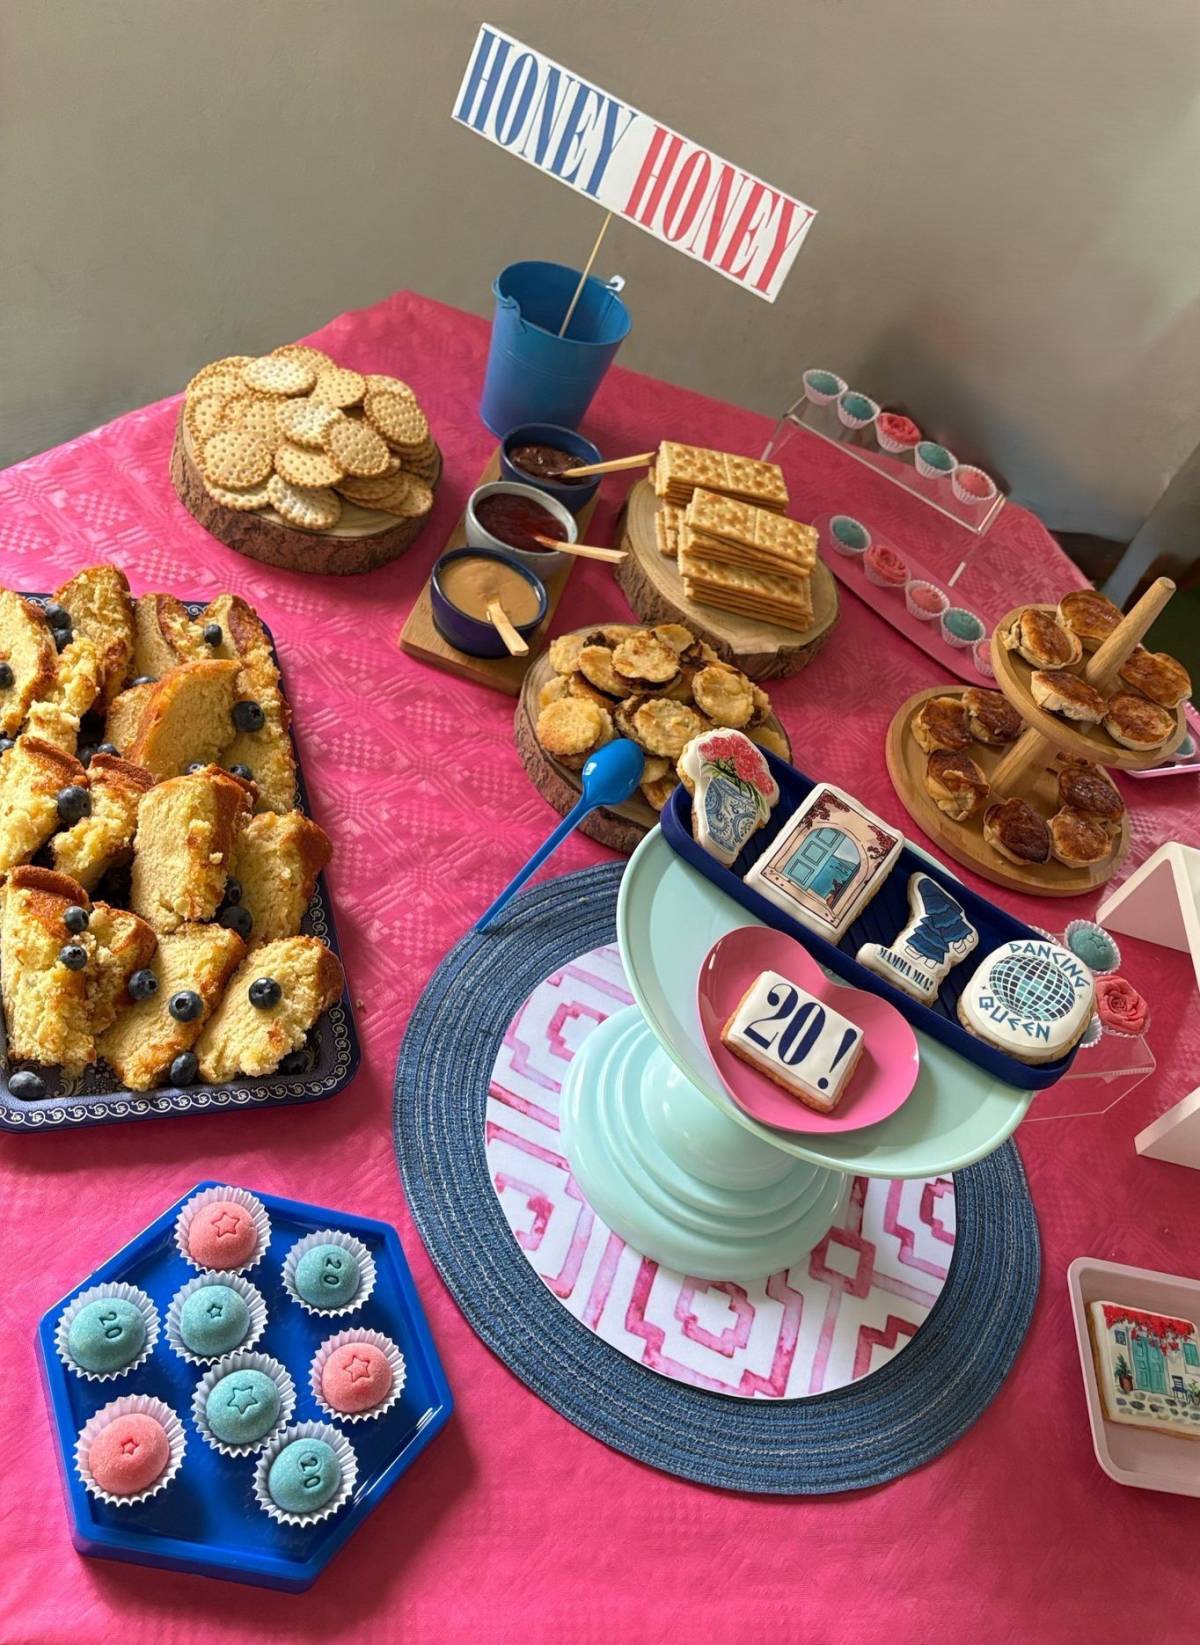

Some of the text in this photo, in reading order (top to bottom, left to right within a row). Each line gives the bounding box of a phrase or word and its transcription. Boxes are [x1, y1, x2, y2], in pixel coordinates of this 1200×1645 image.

[454, 27, 815, 297] HONEY HONEY
[879, 947, 934, 992] MAMMA MIA!
[1008, 942, 1091, 988] DANCING
[743, 983, 858, 1090] 20!
[979, 996, 1051, 1043] QUEEN
[323, 1257, 342, 1286] 20
[98, 1311, 123, 1339] 20
[300, 1456, 321, 1489] 20
